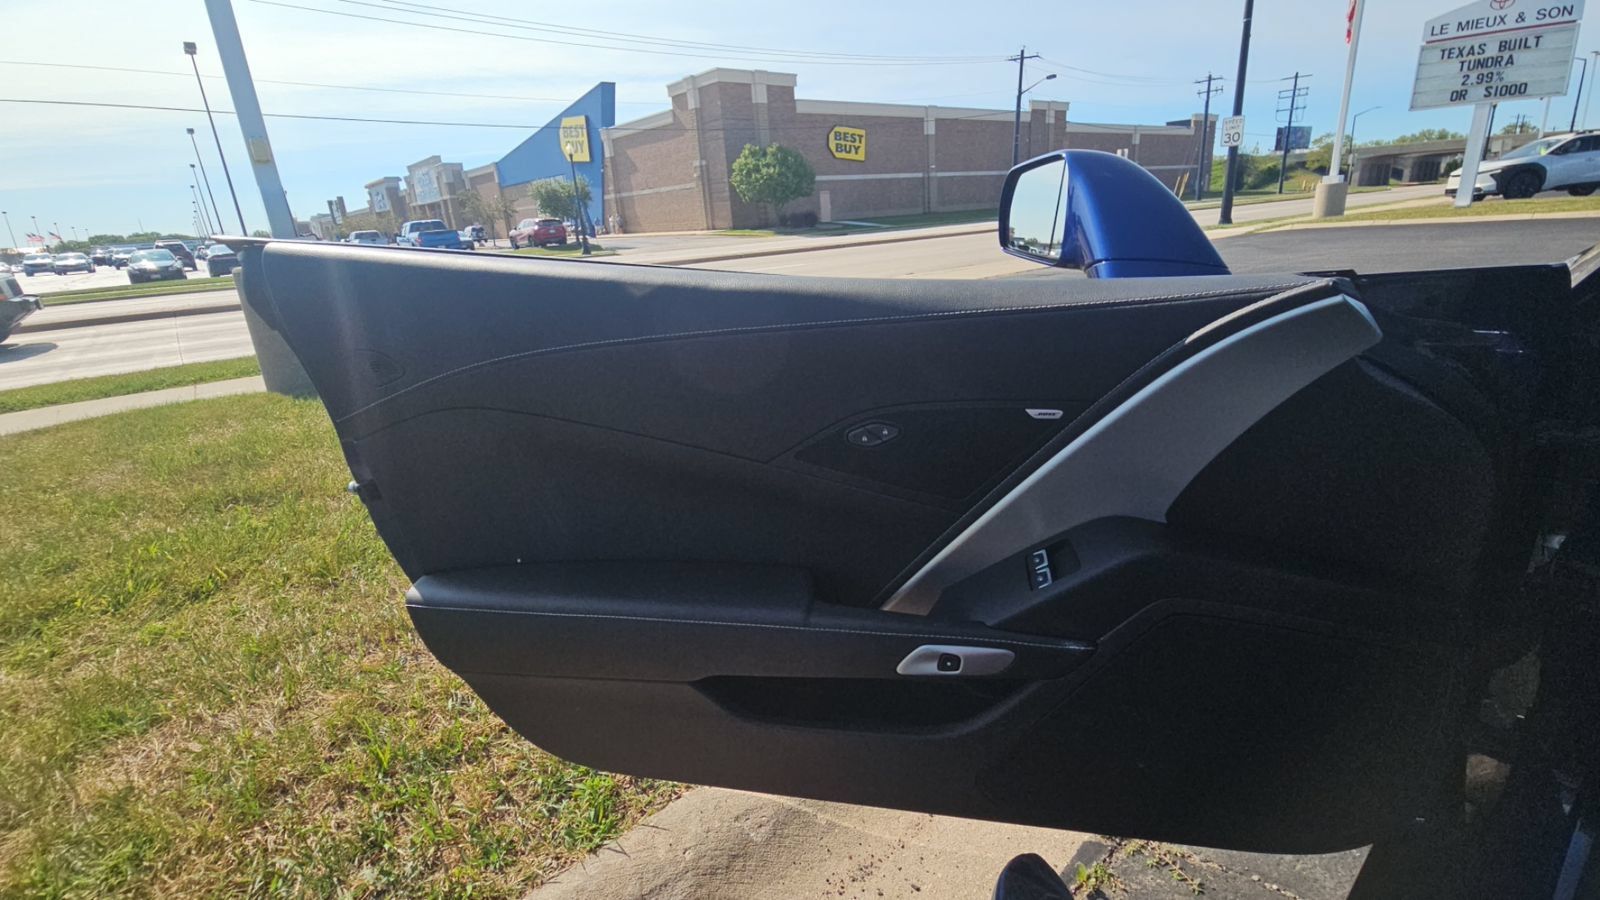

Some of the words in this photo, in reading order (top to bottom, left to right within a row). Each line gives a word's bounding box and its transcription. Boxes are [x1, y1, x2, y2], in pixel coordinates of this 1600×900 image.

[1430, 23, 1450, 37] LE
[1456, 14, 1508, 32] MIEUX
[1515, 11, 1527, 23] &
[1535, 4, 1575, 21] SON
[1440, 43, 1487, 61] TEXAS
[1497, 35, 1544, 53] BUILT
[1459, 54, 1515, 72] TUNDRA
[1461, 71, 1505, 87] 2.99%
[1450, 89, 1468, 102] OR
[562, 124, 586, 139] BEST
[834, 130, 864, 144] BEST
[1223, 131, 1241, 144] 30
[835, 142, 861, 155] BUY
